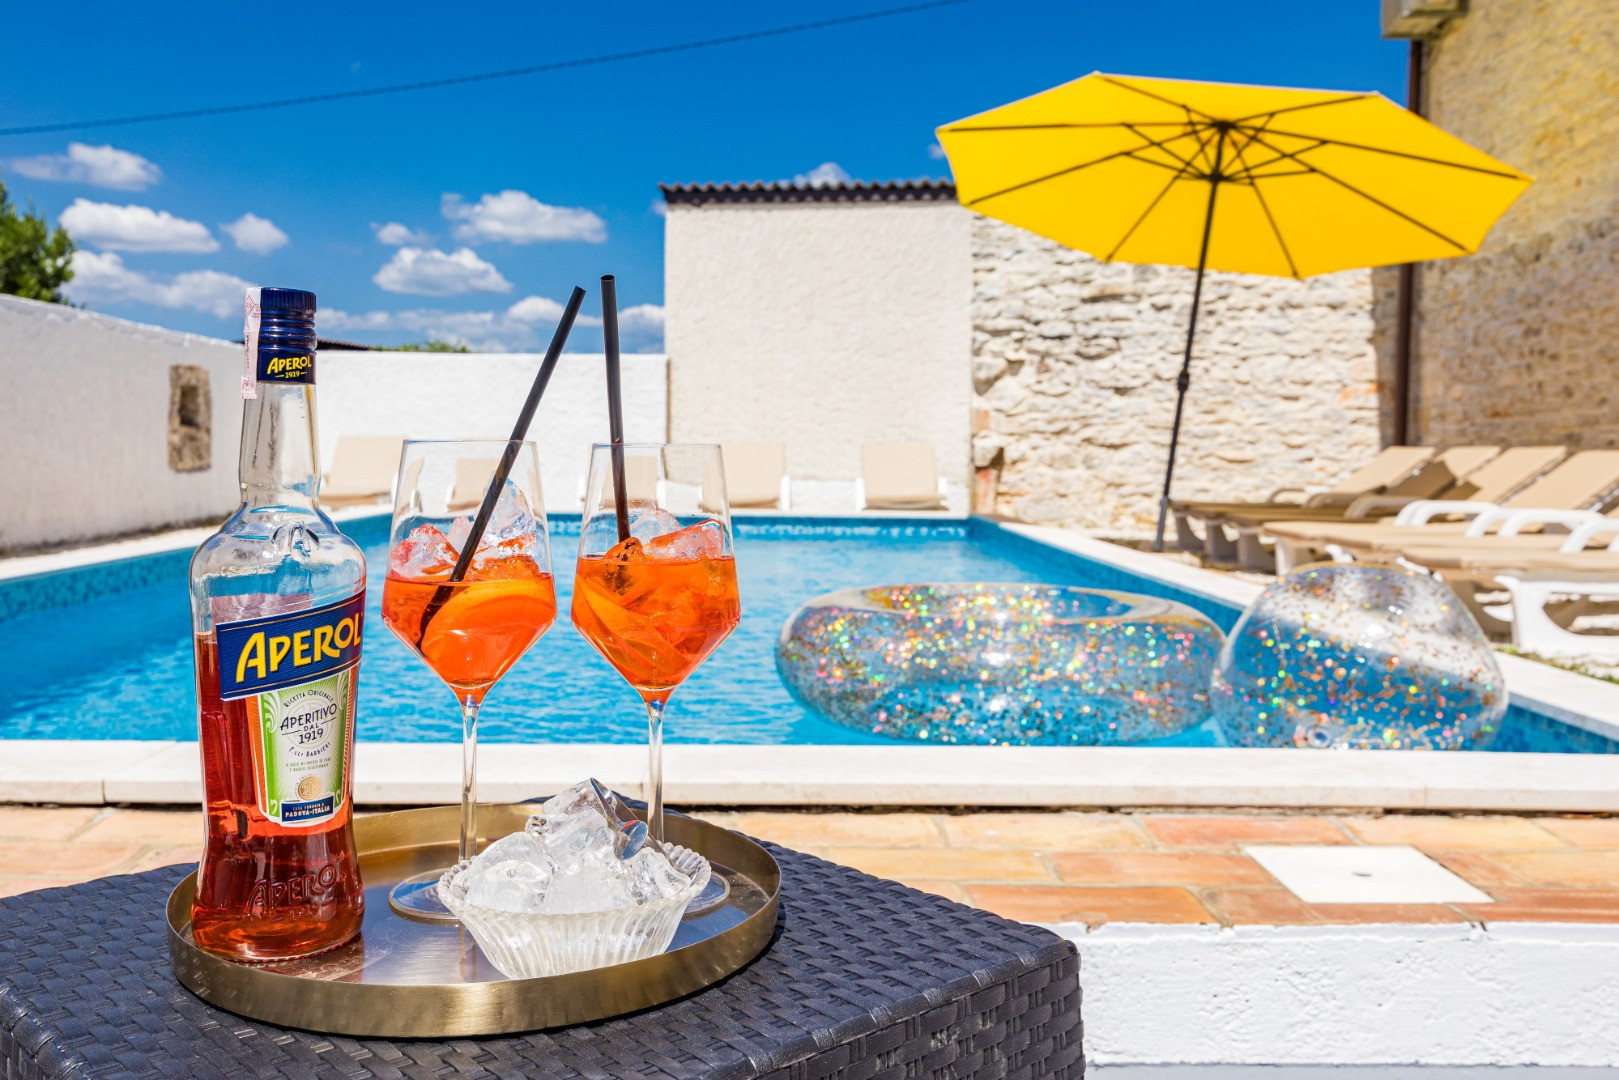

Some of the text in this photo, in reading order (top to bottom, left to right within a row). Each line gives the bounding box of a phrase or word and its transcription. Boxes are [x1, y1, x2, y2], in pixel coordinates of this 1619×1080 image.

[266, 355, 312, 375] APEROL
[285, 370, 300, 379] 1919
[235, 611, 361, 684] APEROL
[283, 689, 334, 707] RICETTA ORIGINALE
[280, 703, 337, 731] APERITIVO
[298, 727, 324, 745] 1919
[303, 722, 320, 732] DAL
[306, 741, 331, 757] BARBIERI
[285, 805, 331, 818] PADOVA-ITALIA
